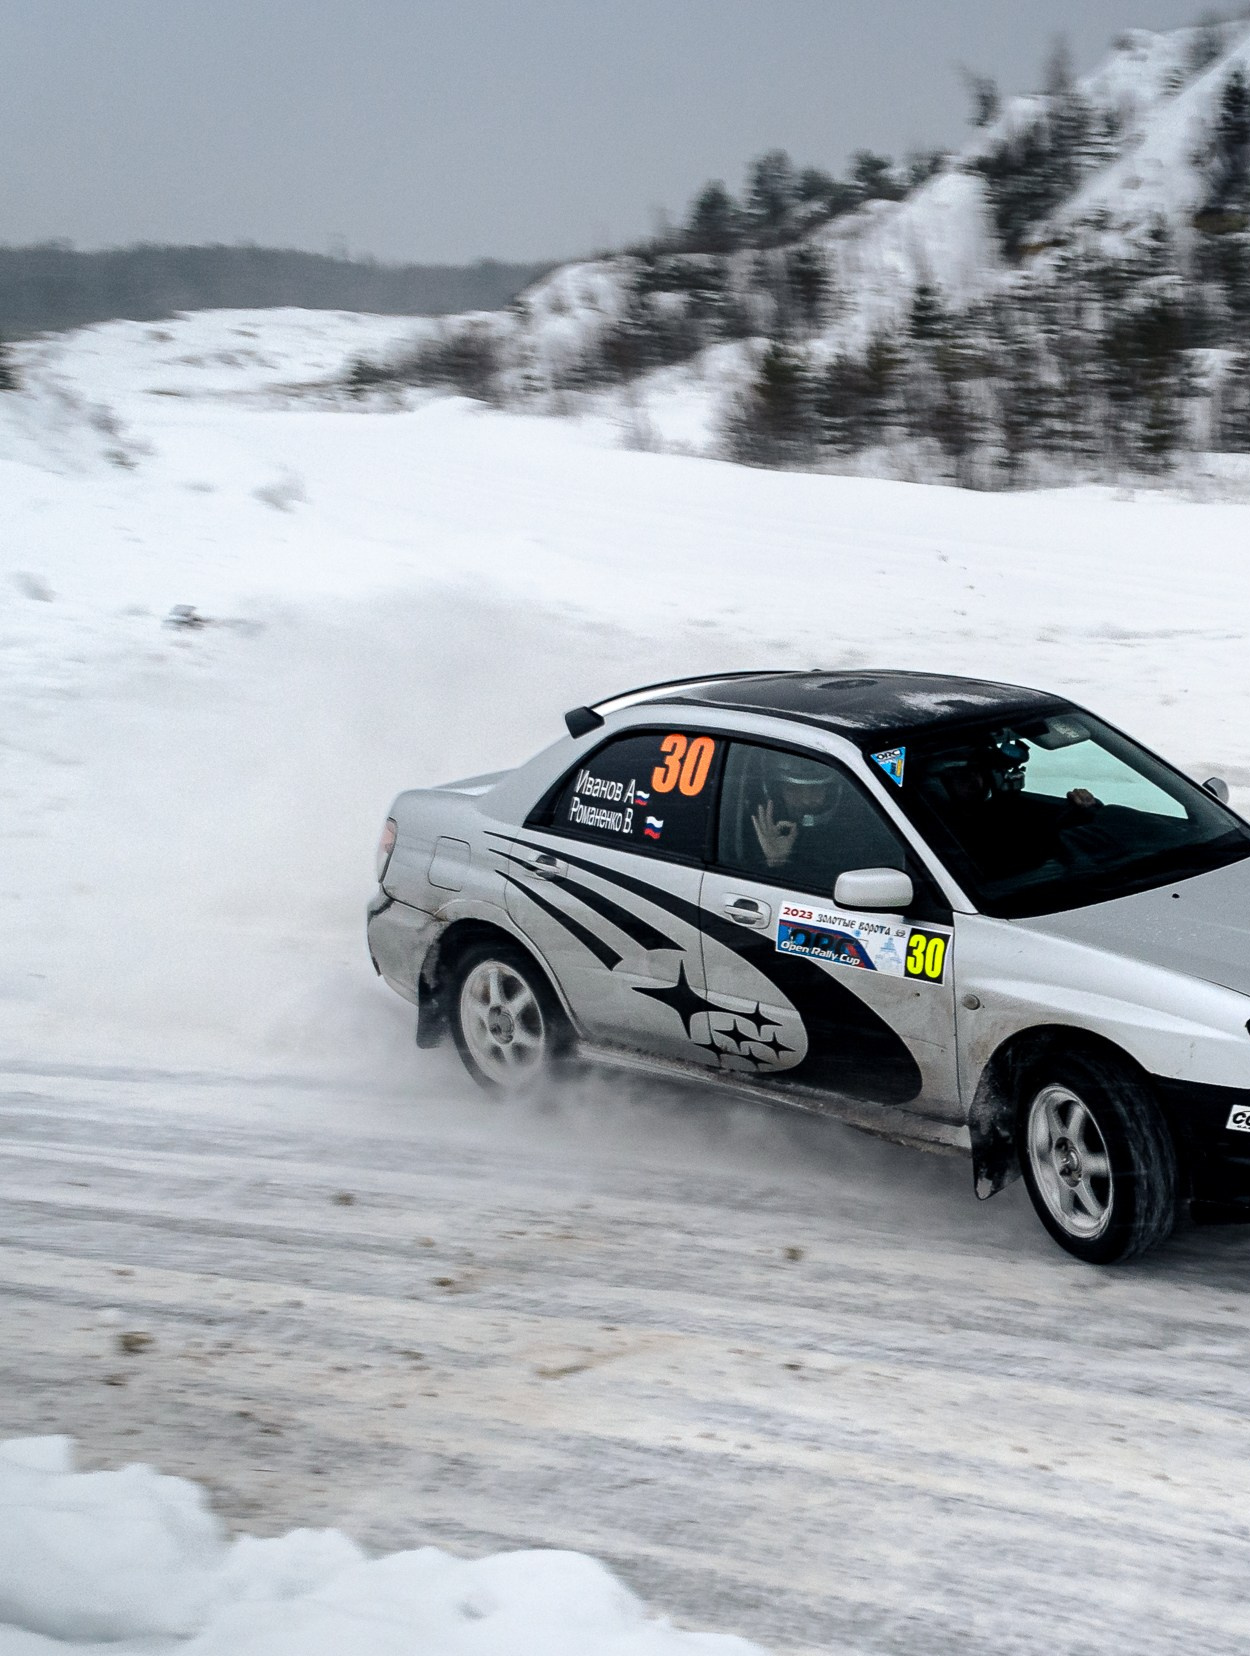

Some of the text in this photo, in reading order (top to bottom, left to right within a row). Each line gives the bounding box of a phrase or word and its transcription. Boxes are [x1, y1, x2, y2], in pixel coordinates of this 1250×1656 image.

[651, 733, 716, 797] 30
[574, 768, 623, 802] Иванов
[568, 796, 634, 834] Романенко В.
[783, 907, 813, 920] 2023
[780, 940, 860, 965] Open Rally Cup
[906, 934, 945, 979] 30
